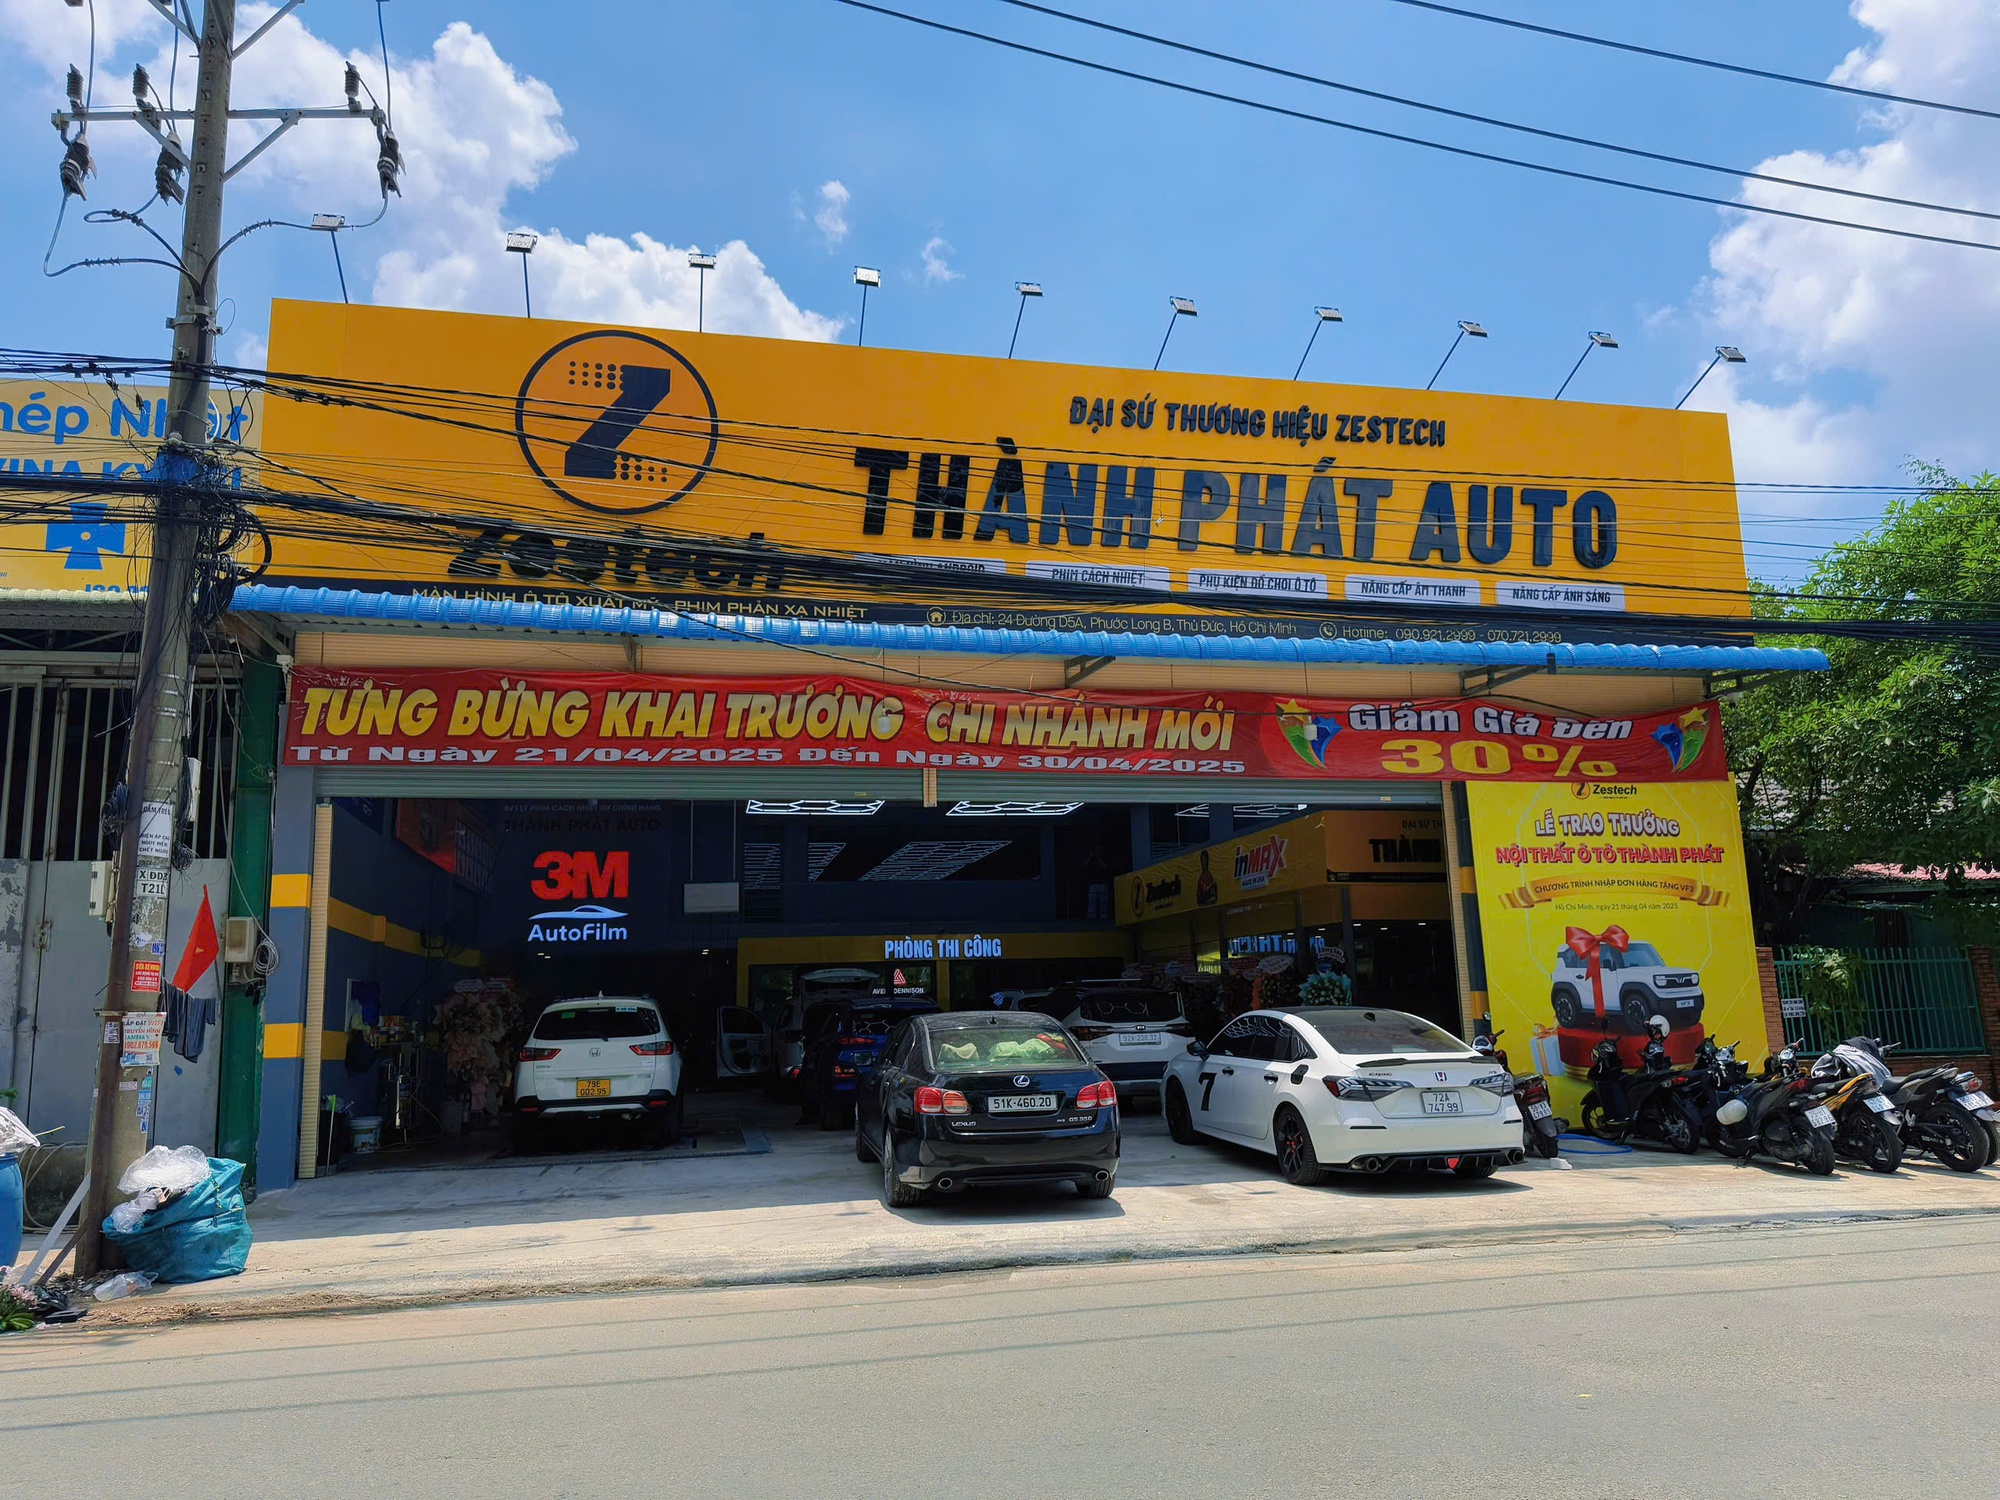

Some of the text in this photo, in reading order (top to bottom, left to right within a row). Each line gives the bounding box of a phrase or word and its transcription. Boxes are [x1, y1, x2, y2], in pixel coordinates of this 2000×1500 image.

[1069, 393, 1446, 447] ĐẠI SỨ THƯƠNG HIỆU ZESTECH
[854, 437, 1617, 570] THÀNH PHÁT AUTO
[1052, 567, 1145, 588] PHIM CÁCH NHIỆT
[1199, 575, 1220, 591] PHỤ
[1223, 574, 1248, 592] KIỆN
[1304, 577, 1316, 592] TÔ
[412, 585, 457, 599] MÀN
[465, 587, 516, 603] HÌNH
[523, 590, 538, 603] Ô
[543, 592, 569, 605] TÔ
[1361, 578, 1466, 598] NÂNG CẤP ÂM THANH
[1512, 585, 1611, 603] NÂNG CẤP ÁNH SÁNG
[674, 599, 868, 620] PHIM PHẢN XẠ NHIỆT
[997, 613, 1013, 626] 24
[1016, 613, 1056, 630] Đường
[1059, 615, 1086, 630] D5A,
[1090, 616, 1128, 630] Phước
[1131, 618, 1160, 634] Long
[1163, 619, 1174, 632] B,
[1177, 618, 1198, 632] Thủ
[1200, 619, 1226, 633] Đức,
[1343, 626, 1562, 643] Hotline: 090.921.2999 070.721.2999
[300, 676, 1236, 751] TƯNG BỪNG KHAI TRƯƠNG CHI NHÁNH MỚI
[1348, 701, 1460, 732] Giảm
[1473, 706, 1542, 736] Giá
[290, 744, 1246, 775] Từ Ngày 21/04/2025 Đến Ngày 30/04/2025
[1381, 739, 1618, 777] 30%
[1593, 784, 1637, 795] Zestech
[1535, 808, 1680, 837] LỄ TRAO THƯỞNG
[1495, 841, 1724, 867] NỘI THẤT Ô TÔ THÀNH PHÁT
[530, 850, 631, 900] 3M
[1534, 878, 1694, 894] CHƯƠNG TRÌNH NHẬP ĐƠN HÀNG TẶNG VF3
[1620, 902, 1638, 911] tháng
[1662, 902, 1678, 910] 2025
[527, 923, 628, 943] AutoFilm
[885, 934, 1002, 959] PHÒNG THI CÔNG
[893, 987, 924, 995] DENNISON
[993, 1097, 1052, 1109] 51K-460.20
[1433, 1093, 1450, 1102] 72A
[1428, 1103, 1459, 1113] 747.99
